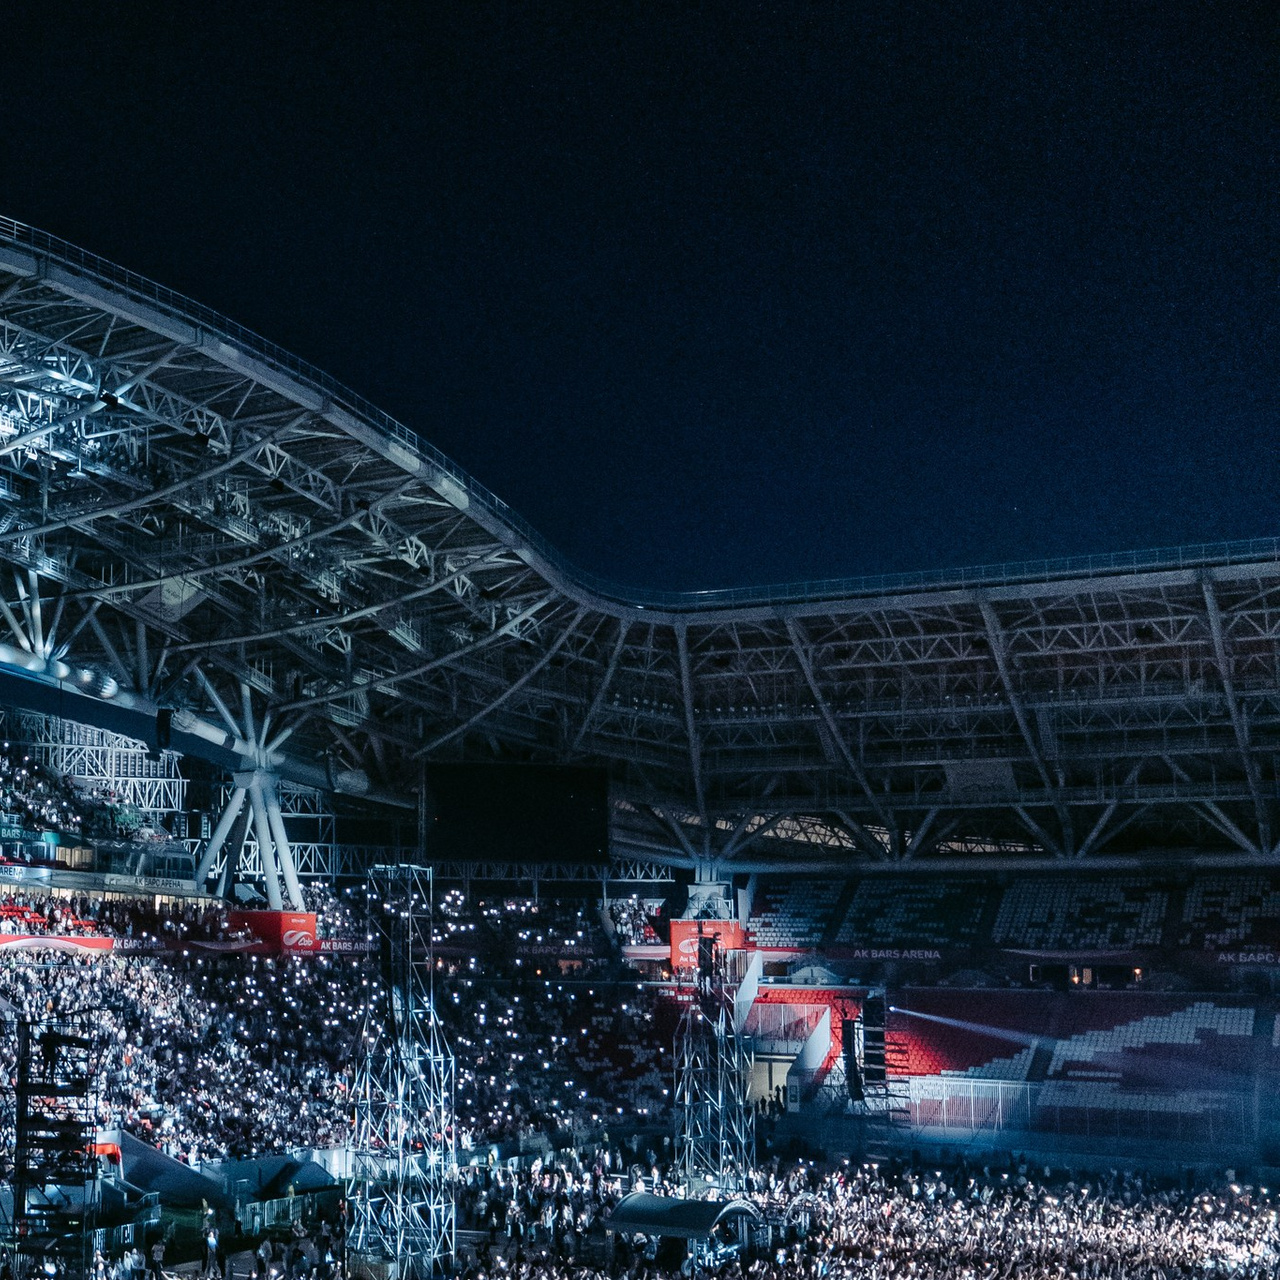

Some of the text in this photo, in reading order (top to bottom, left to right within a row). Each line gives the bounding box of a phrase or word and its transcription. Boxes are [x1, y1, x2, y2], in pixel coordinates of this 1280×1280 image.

[2, 828, 20, 839] BARS
[321, 941, 331, 950] AK
[332, 941, 352, 951] BARS
[854, 949, 941, 959] AK BARS ARENA
